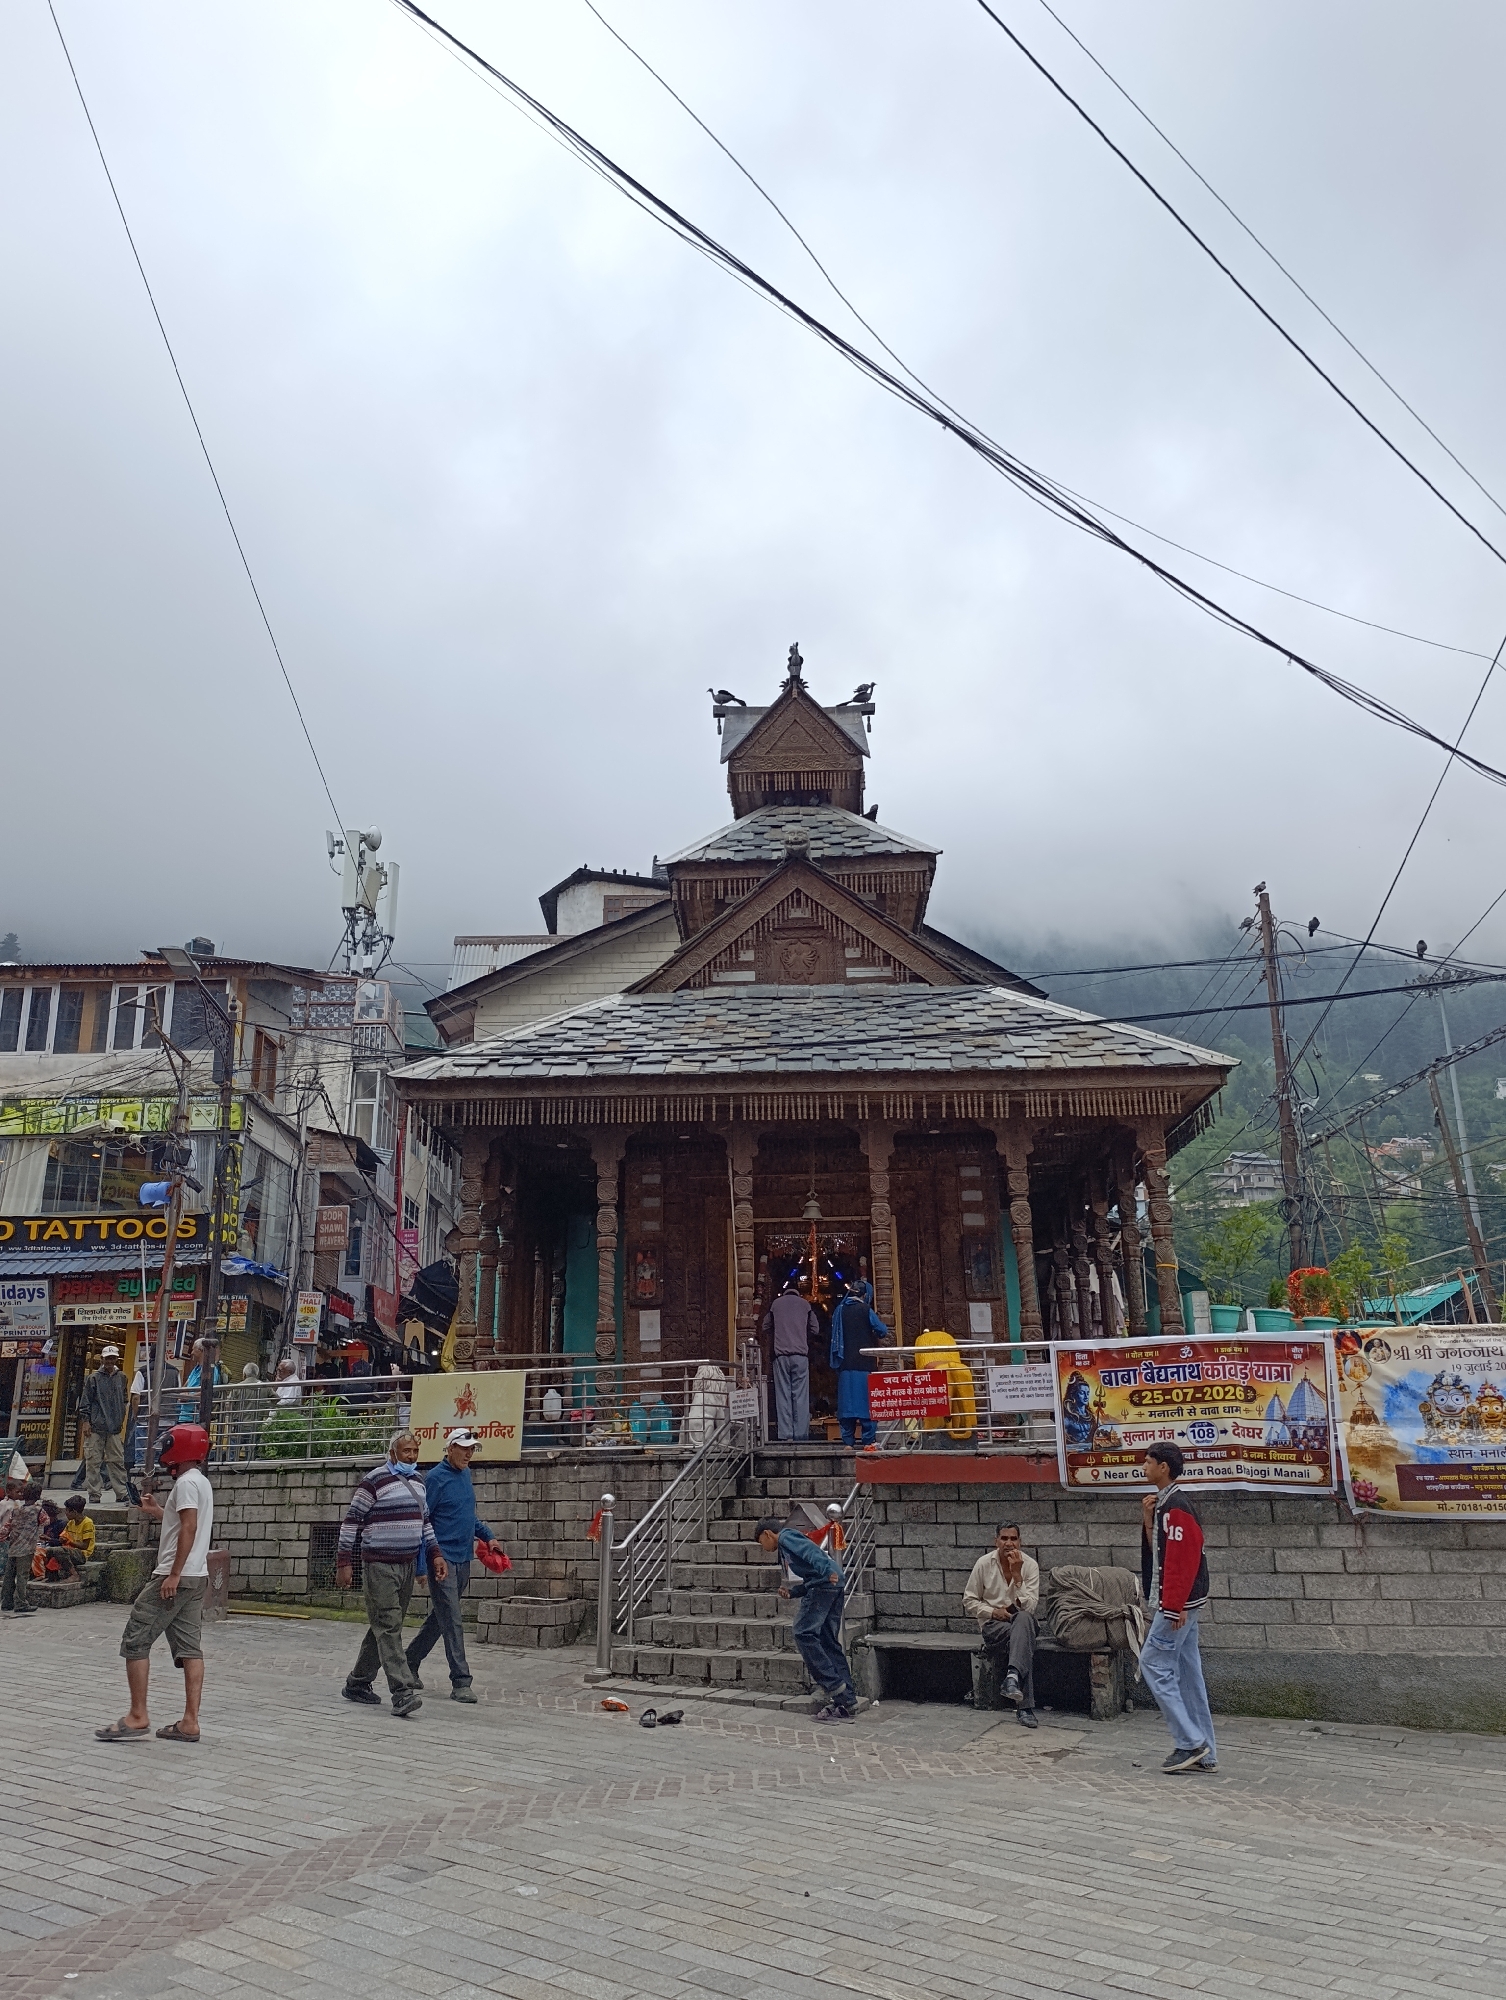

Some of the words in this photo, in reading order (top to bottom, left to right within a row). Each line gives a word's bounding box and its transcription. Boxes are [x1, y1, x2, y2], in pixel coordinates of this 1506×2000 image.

[322, 1209, 343, 1221] BODH
[23, 1218, 197, 1241] TATTOOS
[319, 1223, 345, 1233] SHAWL
[318, 1235, 345, 1247] WEAVERS
[58, 1280, 114, 1299] paras
[117, 1274, 197, 1298] ayured
[299, 1298, 321, 1306] THALI
[1393, 1345, 1411, 1361] श्री
[1415, 1344, 1432, 1360] श्री
[1436, 1345, 1505, 1359] जगन्नाथ
[1099, 1367, 1139, 1388] बाबा
[1140, 1360, 1202, 1385] बैद्यनाथ
[1202, 1355, 1251, 1387] कांवड़
[1251, 1362, 1294, 1383] यात्रा
[1452, 1364, 1462, 1373] 19
[1464, 1360, 1493, 1376] जुलाई
[883, 1376, 900, 1384] जय
[914, 1371, 931, 1386] दुर्गा
[892, 1388, 906, 1396] मास्क
[906, 1386, 913, 1395] के
[925, 1384, 938, 1395] प्रवेश
[1141, 1385, 1245, 1405] 25-07-2026
[1148, 1407, 1184, 1419] मनाली
[1187, 1406, 1197, 1417] से
[1222, 1405, 1242, 1414] धाम
[477, 1420, 516, 1439] मन्दिर
[1122, 1430, 1156, 1446] सुल्तान
[1158, 1426, 1175, 1441] गंज
[1190, 1428, 1216, 1439] 108
[1230, 1421, 1264, 1440] देवघर
[1249, 1452, 1266, 1460] नमः
[1269, 1451, 1297, 1462] शिवाय
[1104, 1470, 1129, 1480] Near
[1274, 1467, 1310, 1479] Manali
[1167, 1525, 1184, 1542] 16
